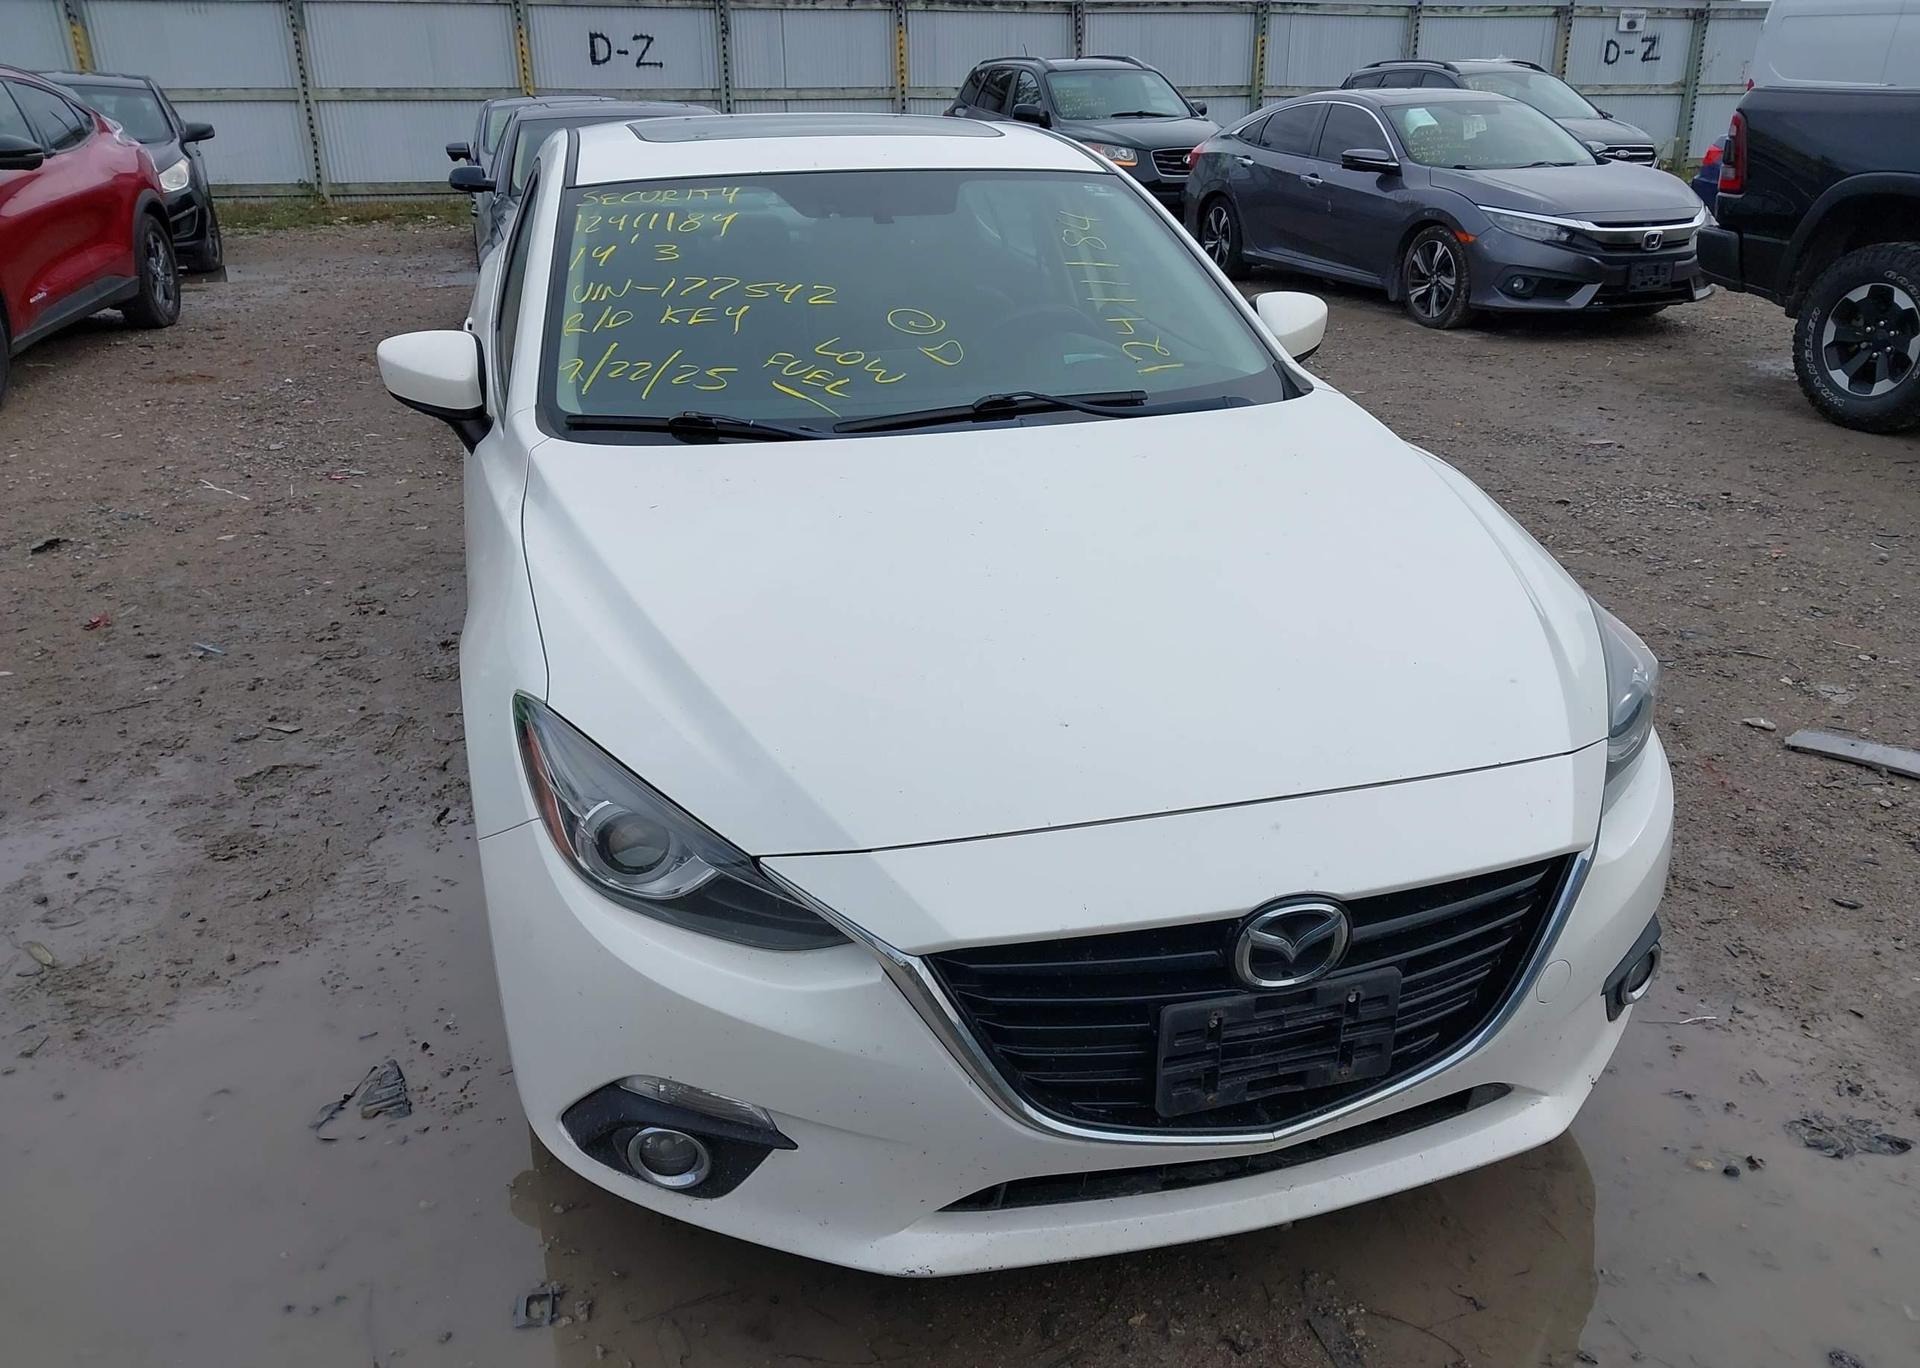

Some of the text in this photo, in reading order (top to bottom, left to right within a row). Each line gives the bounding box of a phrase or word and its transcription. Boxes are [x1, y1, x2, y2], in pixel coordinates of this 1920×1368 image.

[576, 187, 741, 207] SECURITY
[660, 304, 750, 335] KEY
[762, 352, 851, 398] FUEL
[814, 336, 907, 384] LOW
